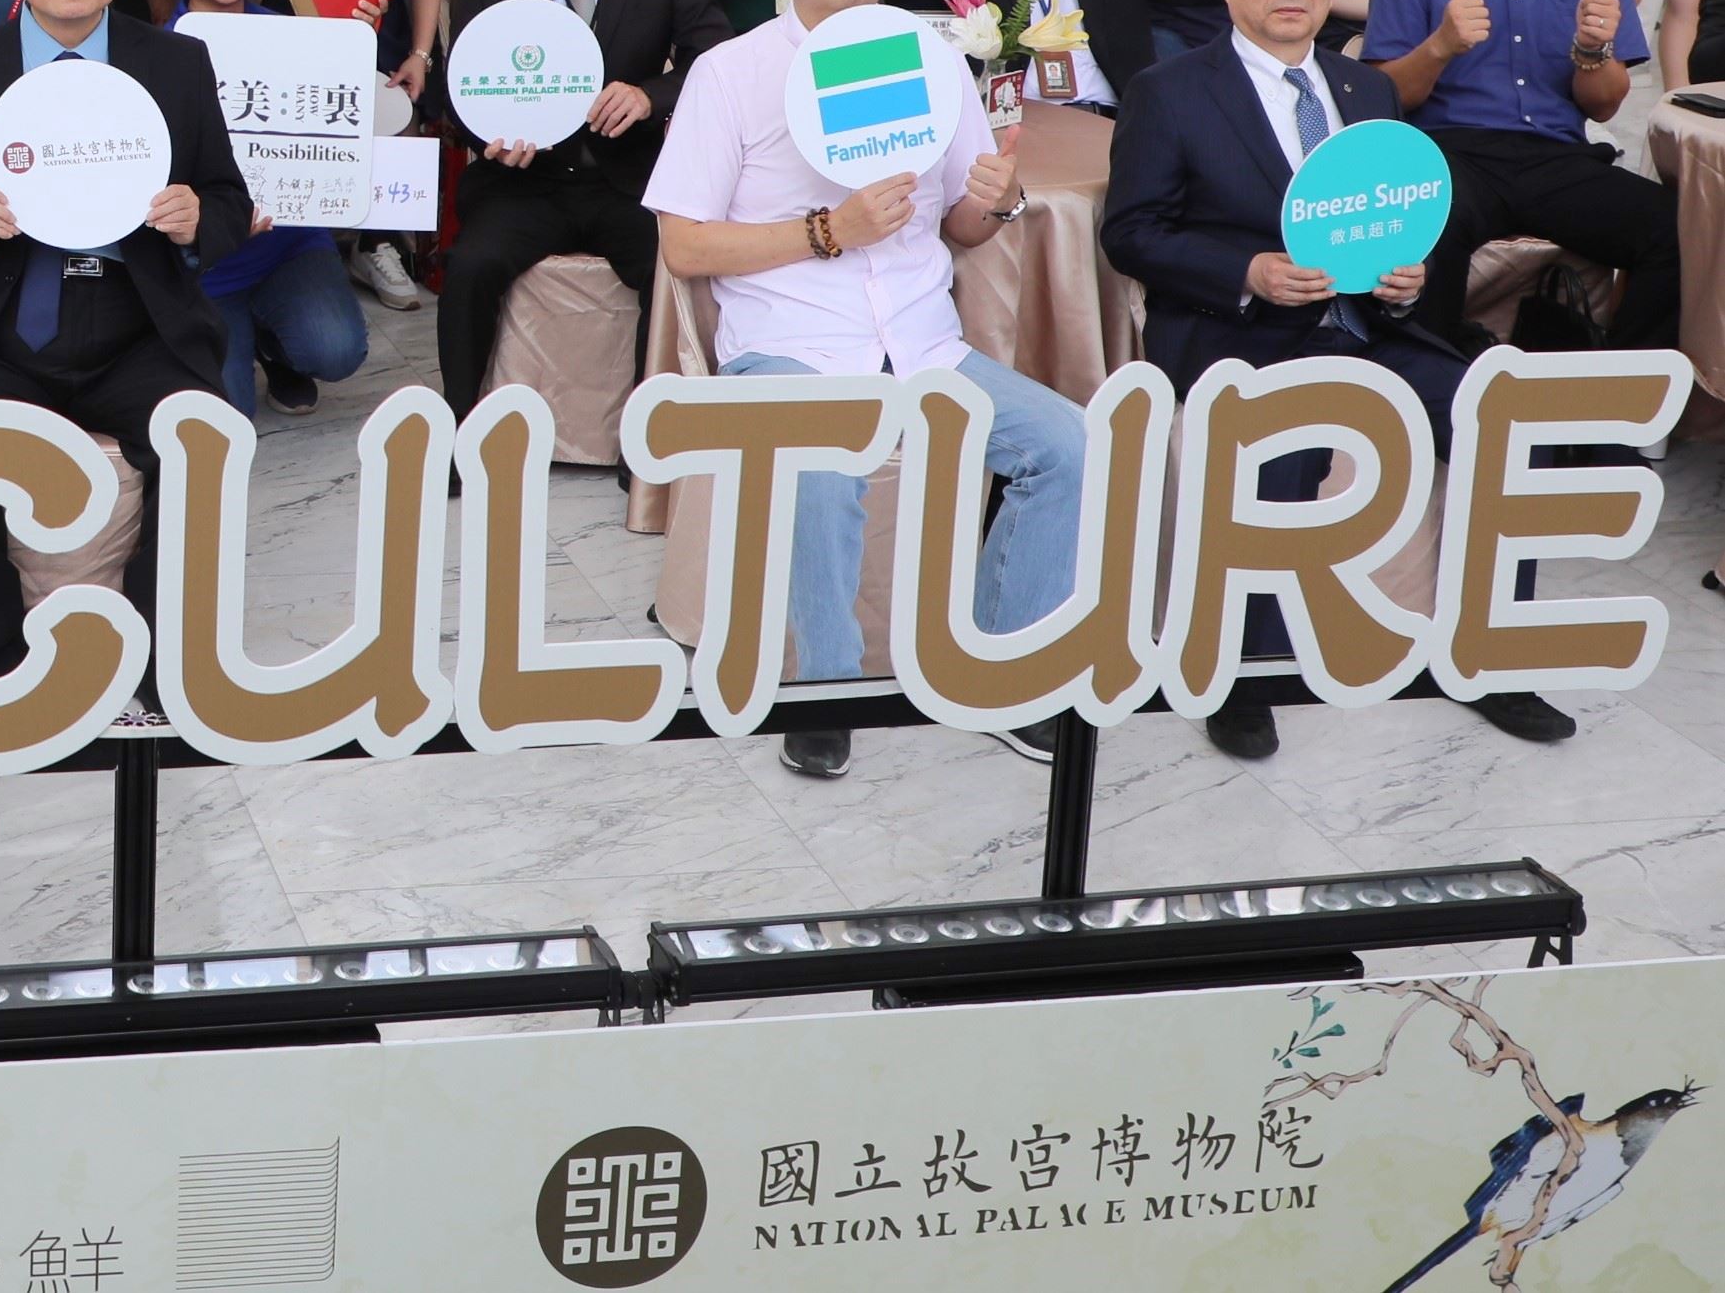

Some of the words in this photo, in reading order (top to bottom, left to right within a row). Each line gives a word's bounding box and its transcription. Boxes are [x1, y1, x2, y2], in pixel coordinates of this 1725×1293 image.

[295, 83, 306, 123] MANY
[310, 84, 319, 117] HOW
[460, 87, 519, 97] EVERGREEN
[522, 85, 561, 95] PALACE
[563, 84, 595, 94] HOTEL
[42, 137, 151, 158] 國立故宮博物院
[43, 159, 82, 167] NATIONAL
[84, 155, 114, 164] PALACE
[116, 152, 151, 161] MUSEUM
[248, 142, 361, 163] Possibilities.
[825, 126, 936, 165] FamilyMart
[1290, 193, 1368, 224] Breeze
[1373, 179, 1443, 215] Super
[1329, 218, 1405, 246] 微風超市
[758, 1109, 1325, 1209] 國立故宮博物院
[754, 1209, 959, 1252] NATIONAL
[974, 1195, 1128, 1240] PALACE
[1143, 1182, 1319, 1228] MUSEUM
